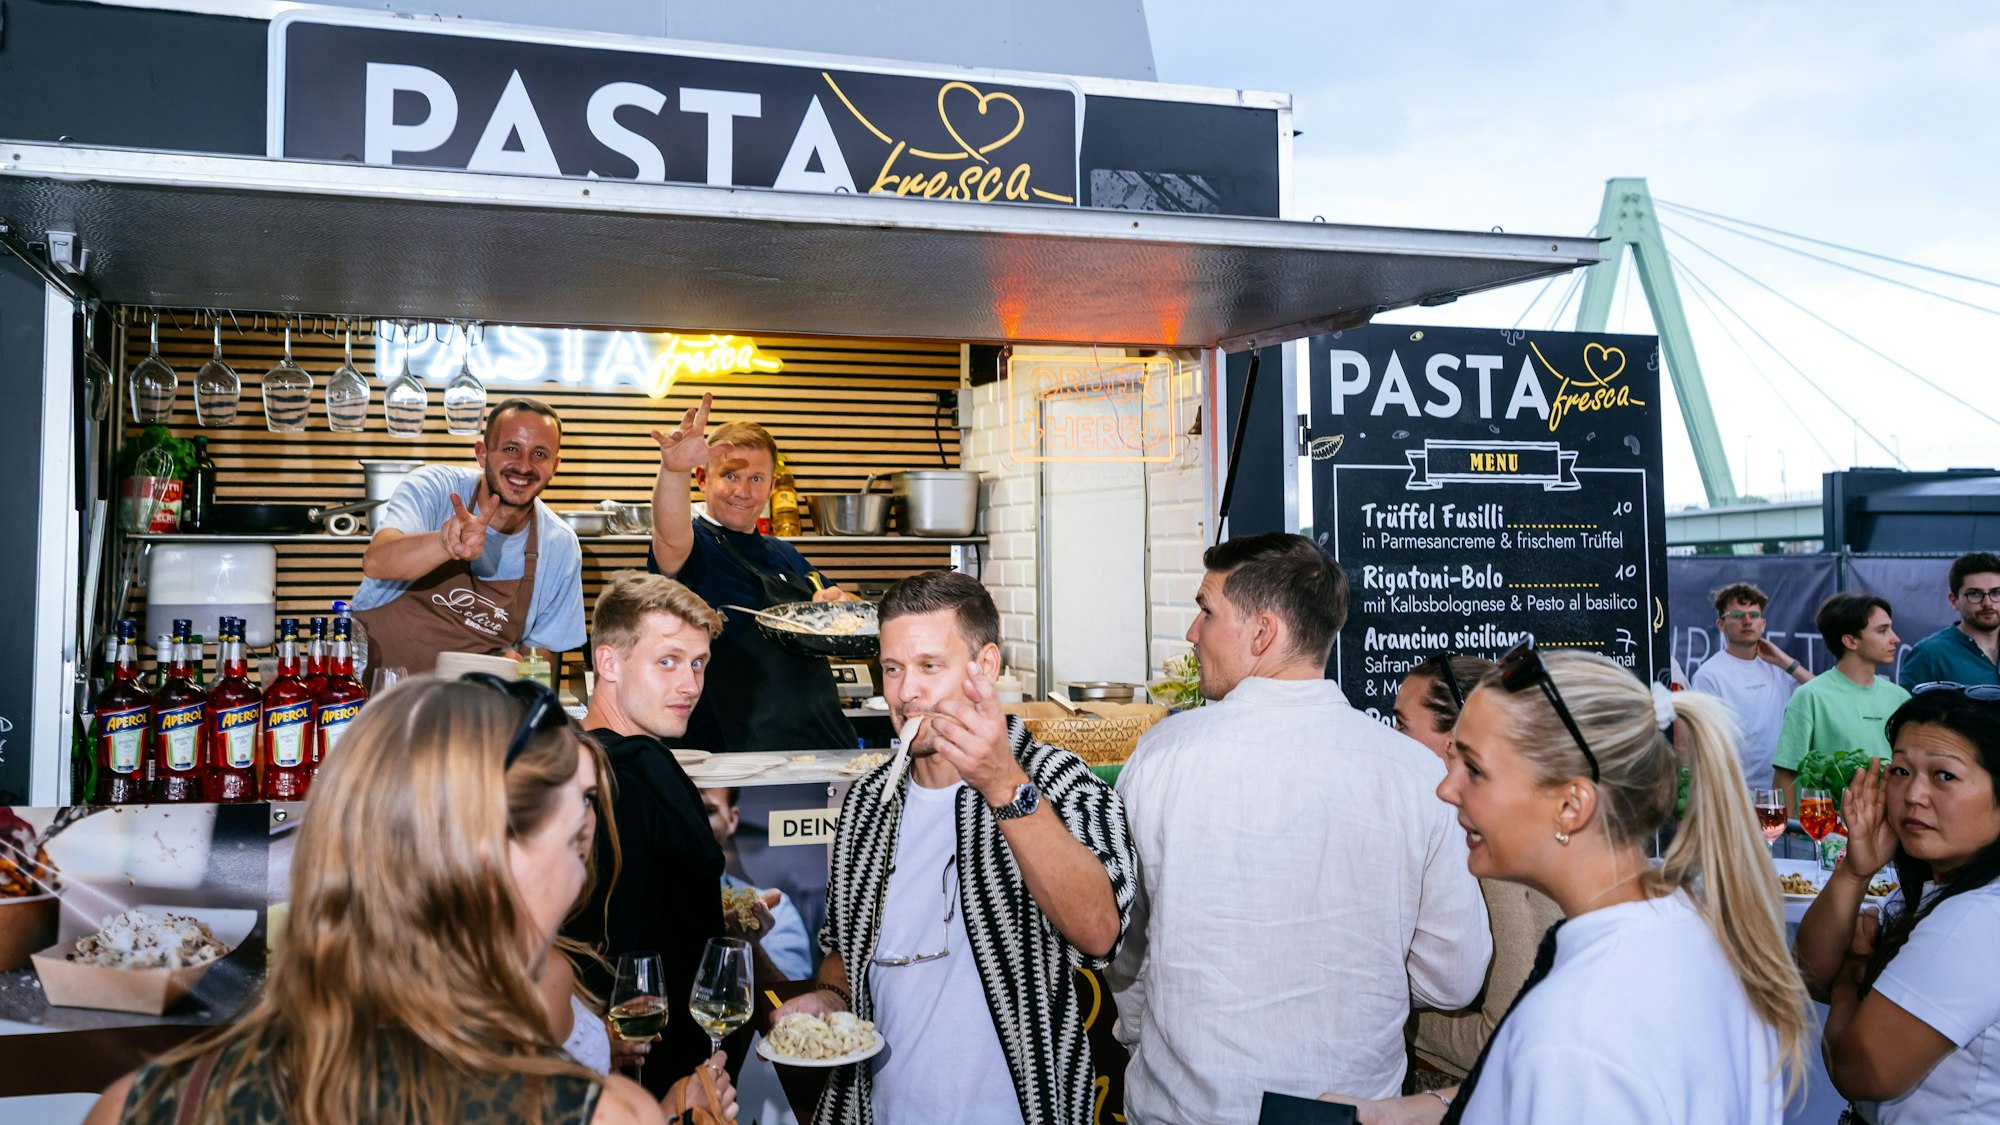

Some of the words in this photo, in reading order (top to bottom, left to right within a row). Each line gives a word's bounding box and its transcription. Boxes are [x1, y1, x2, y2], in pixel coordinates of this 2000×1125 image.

[364, 62, 857, 193] PASTA
[1028, 365, 1156, 403] ORDER
[1330, 349, 1550, 420] PASTA
[1549, 377, 1630, 432] fresca
[1046, 415, 1142, 450] HERE
[1470, 453, 1519, 472] MENU
[1361, 502, 1435, 530] Trüffel
[1441, 503, 1504, 530] Fusilli
[1612, 501, 1633, 517] 10
[1362, 532, 1376, 549] in
[1380, 532, 1496, 549] Parmesancreme
[1500, 532, 1512, 549] &
[1517, 531, 1576, 549] frischem
[1580, 531, 1624, 549] Trüffel
[1362, 562, 1504, 596] Rigatoni-Bolo
[1614, 564, 1637, 581] 10
[1363, 596, 1386, 613] mit
[1390, 593, 1506, 616] Kalbsbolognese
[1510, 594, 1522, 611] &
[1527, 594, 1565, 611] Pesto
[1569, 593, 1581, 610] al
[1585, 592, 1638, 610] basilico
[1364, 625, 1449, 651] Arancino
[1365, 678, 1378, 697] &
[106, 713, 147, 732] APEROL
[162, 709, 203, 730] APEROL
[222, 707, 260, 728] APEROL
[268, 707, 308, 727] APEROL
